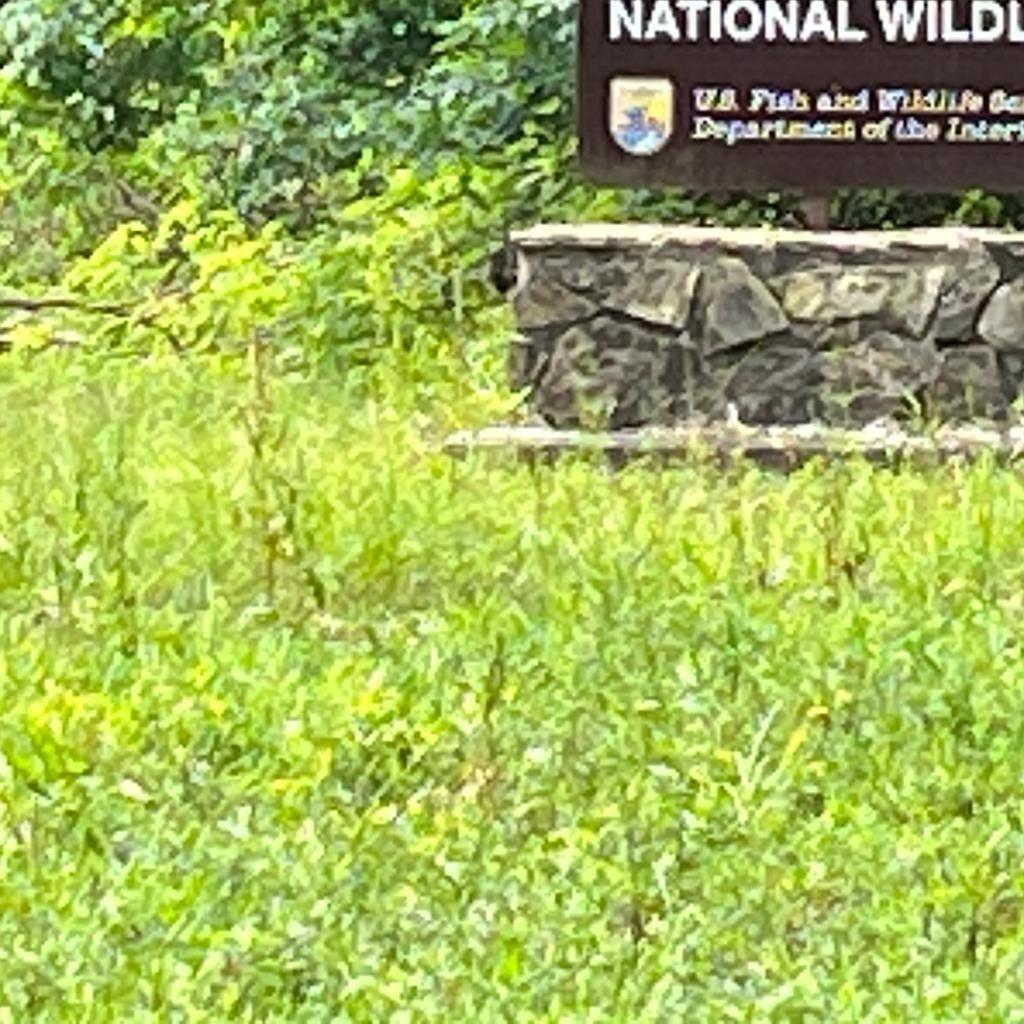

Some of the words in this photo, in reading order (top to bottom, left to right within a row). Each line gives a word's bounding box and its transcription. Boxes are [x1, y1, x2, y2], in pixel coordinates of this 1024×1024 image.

[692, 88, 739, 112] U.S.
[747, 88, 811, 113] Fish
[815, 88, 870, 113] and
[876, 88, 984, 114] Wildlife
[690, 116, 857, 146] Department
[861, 116, 893, 142] of
[894, 116, 941, 142] the
